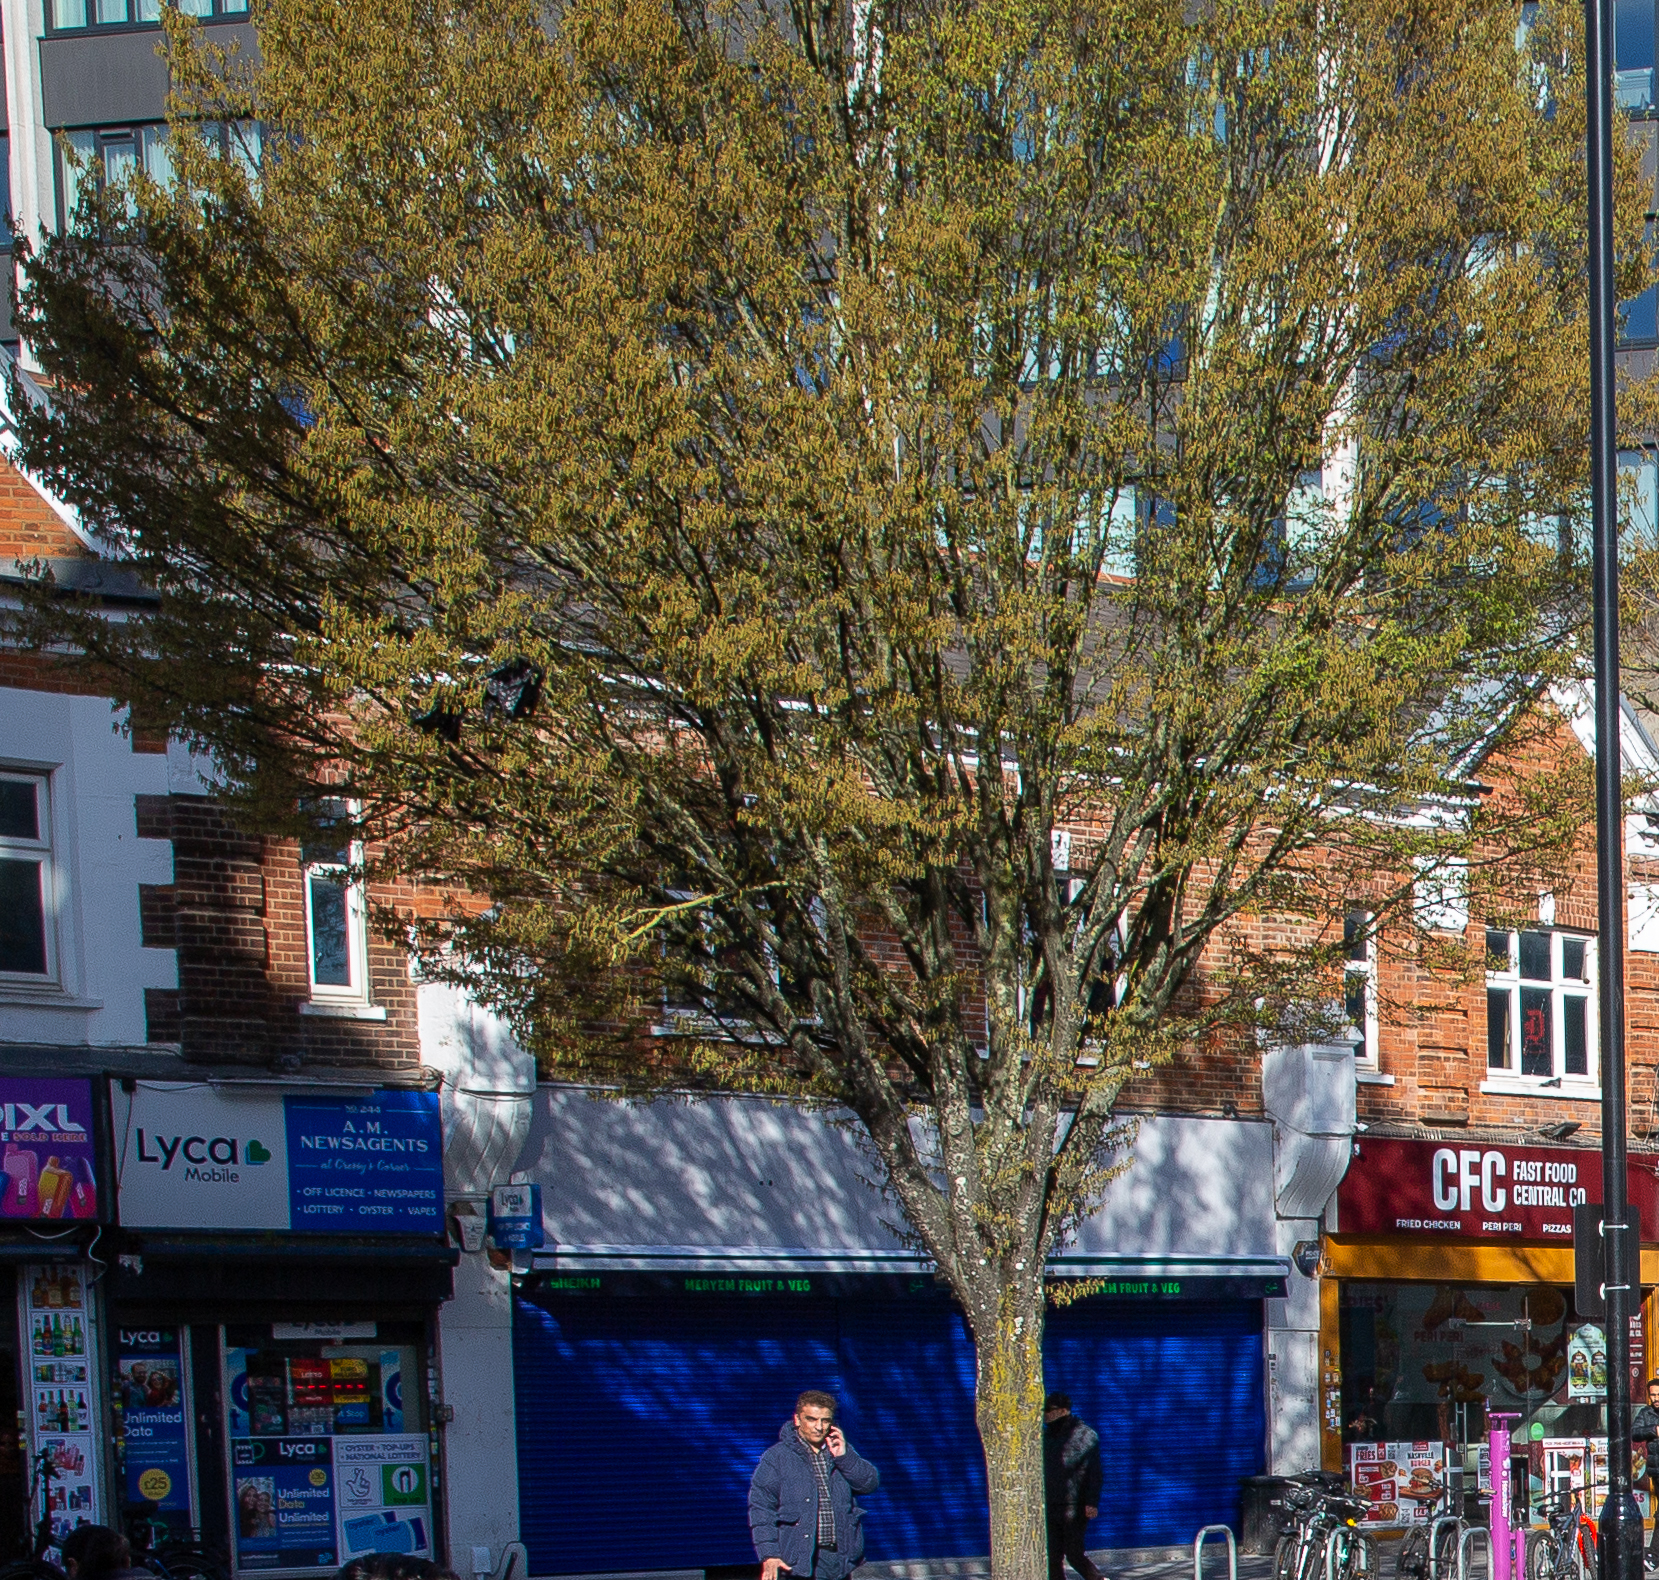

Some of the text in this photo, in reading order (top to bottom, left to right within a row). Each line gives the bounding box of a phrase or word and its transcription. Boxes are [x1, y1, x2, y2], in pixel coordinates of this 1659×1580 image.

[0, 1103, 86, 1132] IXL
[343, 1120, 389, 1135] A.M.
[13, 1132, 48, 1142] SOLD
[52, 1132, 88, 1142] HERE
[300, 1135, 429, 1152] NEWSAGENTS
[136, 1128, 239, 1170] Lyca
[184, 1168, 240, 1183] Mobile
[1513, 1160, 1577, 1184] FAST FOOD
[1433, 1148, 1506, 1212] CFC
[303, 1187, 436, 1199] OFF LICENCE NEWSPAPERS
[1513, 1185, 1567, 1207] CENTRAL
[303, 1204, 437, 1216] LOTTERY OYSTER VAPES
[1396, 1218, 1461, 1231] FRIED CHICKEN
[1482, 1221, 1522, 1232] PERI PERI
[1542, 1223, 1572, 1234] PIZZAS
[739, 1279, 773, 1292] FRUIT
[788, 1279, 811, 1292] VEG
[1120, 1283, 1148, 1294] FRUIT
[1161, 1283, 1180, 1294] VEG
[119, 1329, 160, 1345] Lyca
[279, 1441, 316, 1457] Lyca
[345, 1452, 421, 1460] NATIONAL LOTTERY
[277, 1488, 330, 1499] Unlimited
[278, 1500, 305, 1510] Data
[279, 1511, 330, 1523] Unlimited
